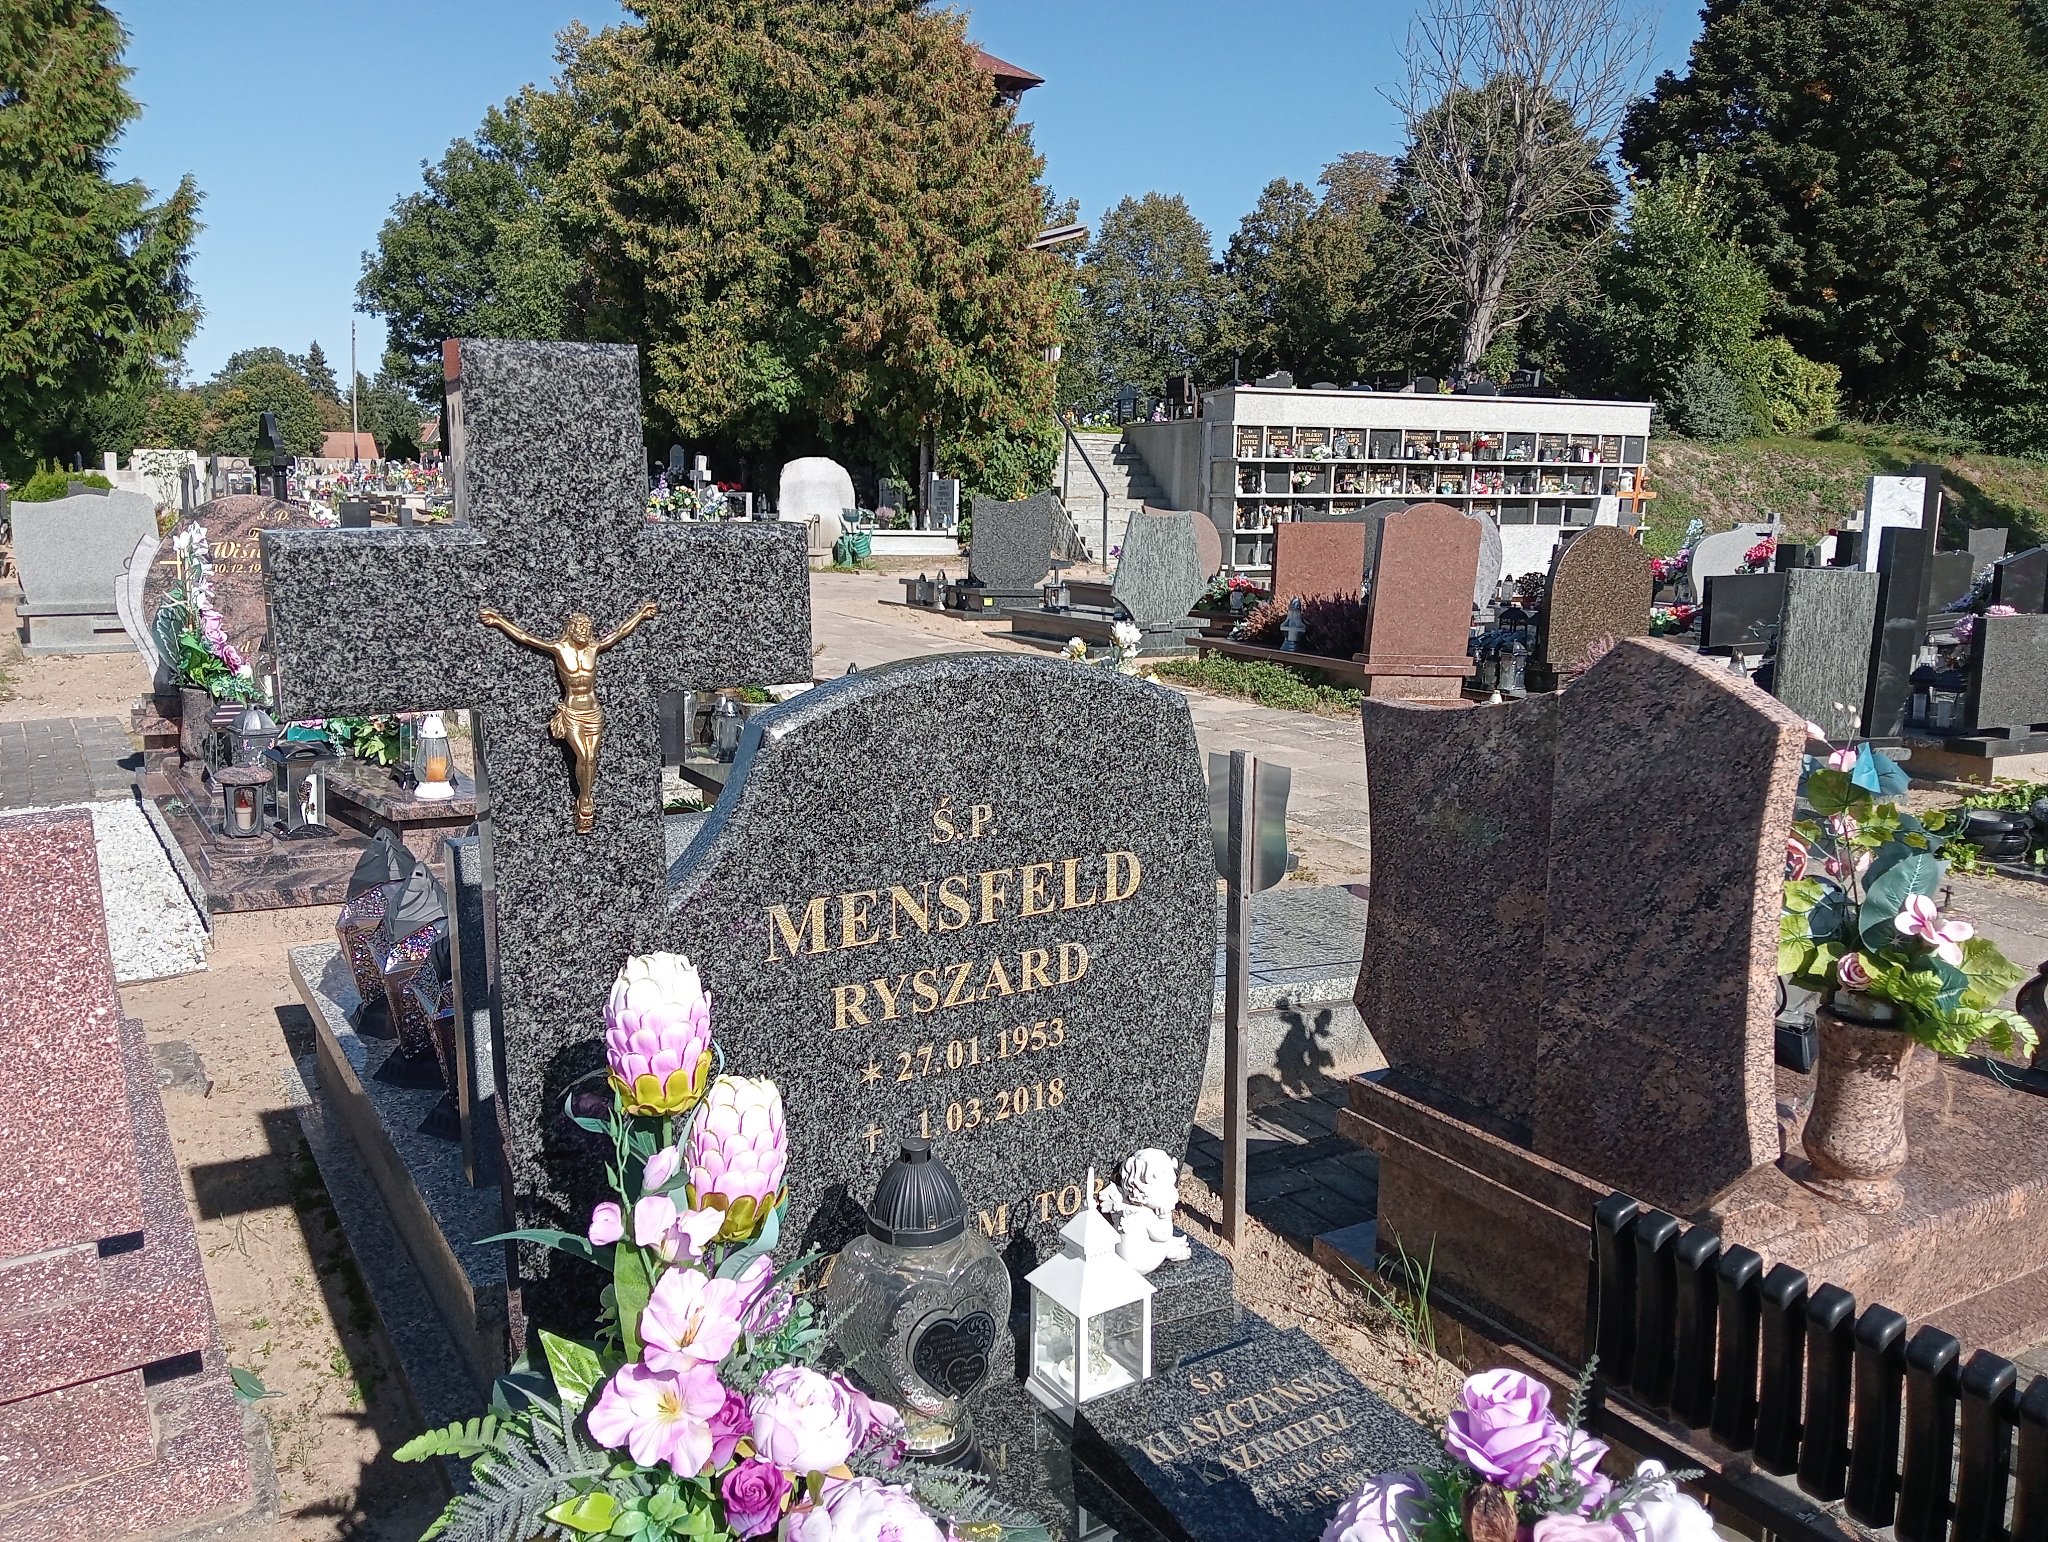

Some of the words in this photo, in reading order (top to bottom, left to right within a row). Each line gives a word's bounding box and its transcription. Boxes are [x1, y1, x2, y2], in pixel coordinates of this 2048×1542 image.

[763, 850, 1143, 964] MENSFELD
[829, 941, 1090, 1032] RYSZARD
[896, 1016, 1065, 1083] 27.01.1953
[917, 1077, 1065, 1139] 1.03.2018
[1135, 1367, 1350, 1466] KLASZCZYŃSKI
[1189, 1406, 1358, 1487] KAZIMIERZ
